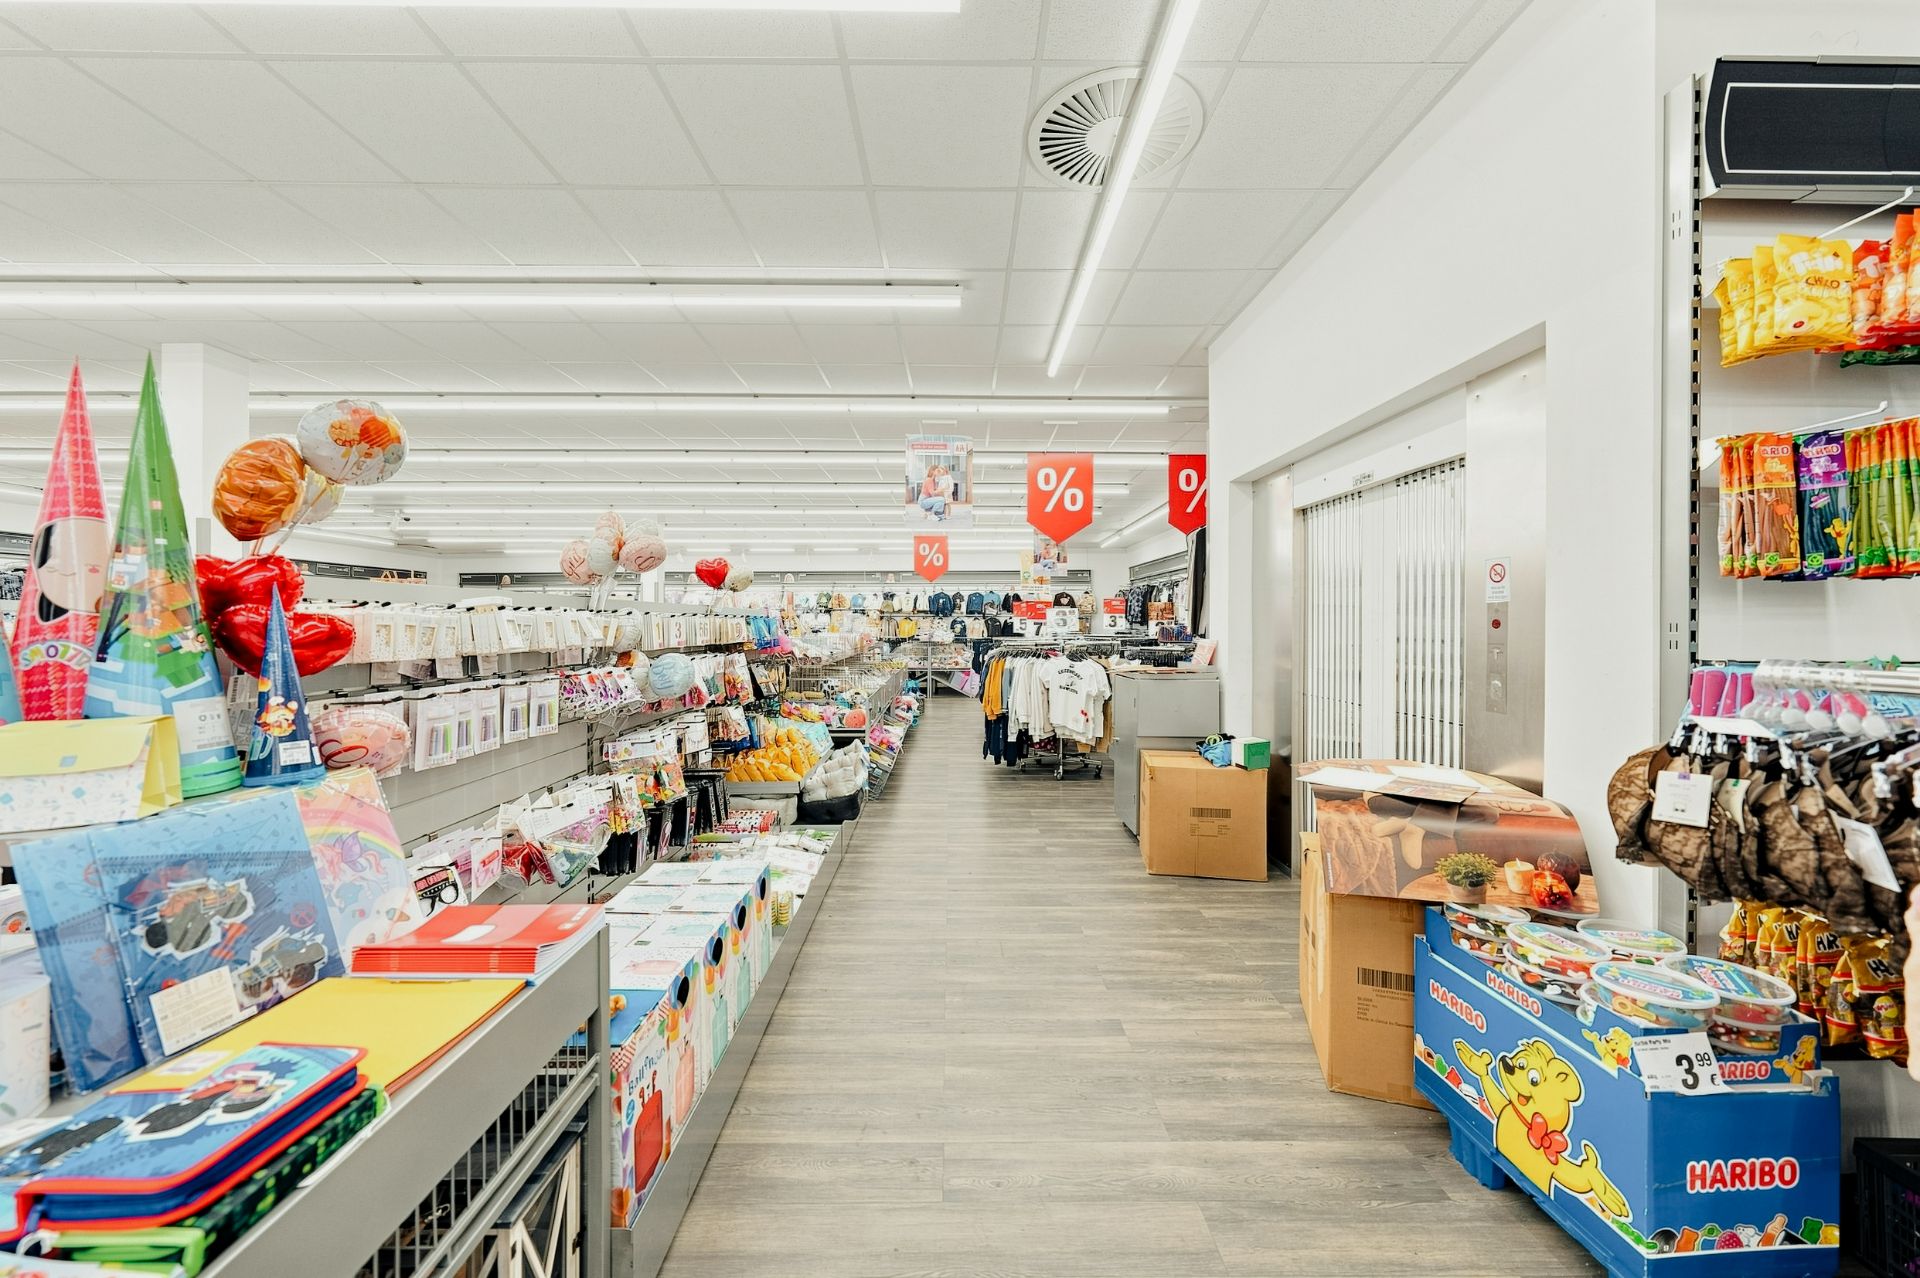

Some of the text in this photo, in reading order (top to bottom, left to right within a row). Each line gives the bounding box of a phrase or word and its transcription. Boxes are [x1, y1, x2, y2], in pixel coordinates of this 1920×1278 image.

[1036, 467, 1084, 513] %
[919, 543, 944, 567] %
[1033, 622, 1043, 636] 7
[1428, 978, 1486, 1033] HARIBO
[1486, 971, 1543, 1017] HARIBO
[1675, 1054, 1699, 1090] 3
[1695, 1052, 1712, 1067] 99
[1718, 1061, 1771, 1080] ARIBO
[1687, 1155, 1800, 1195] HARIBO
